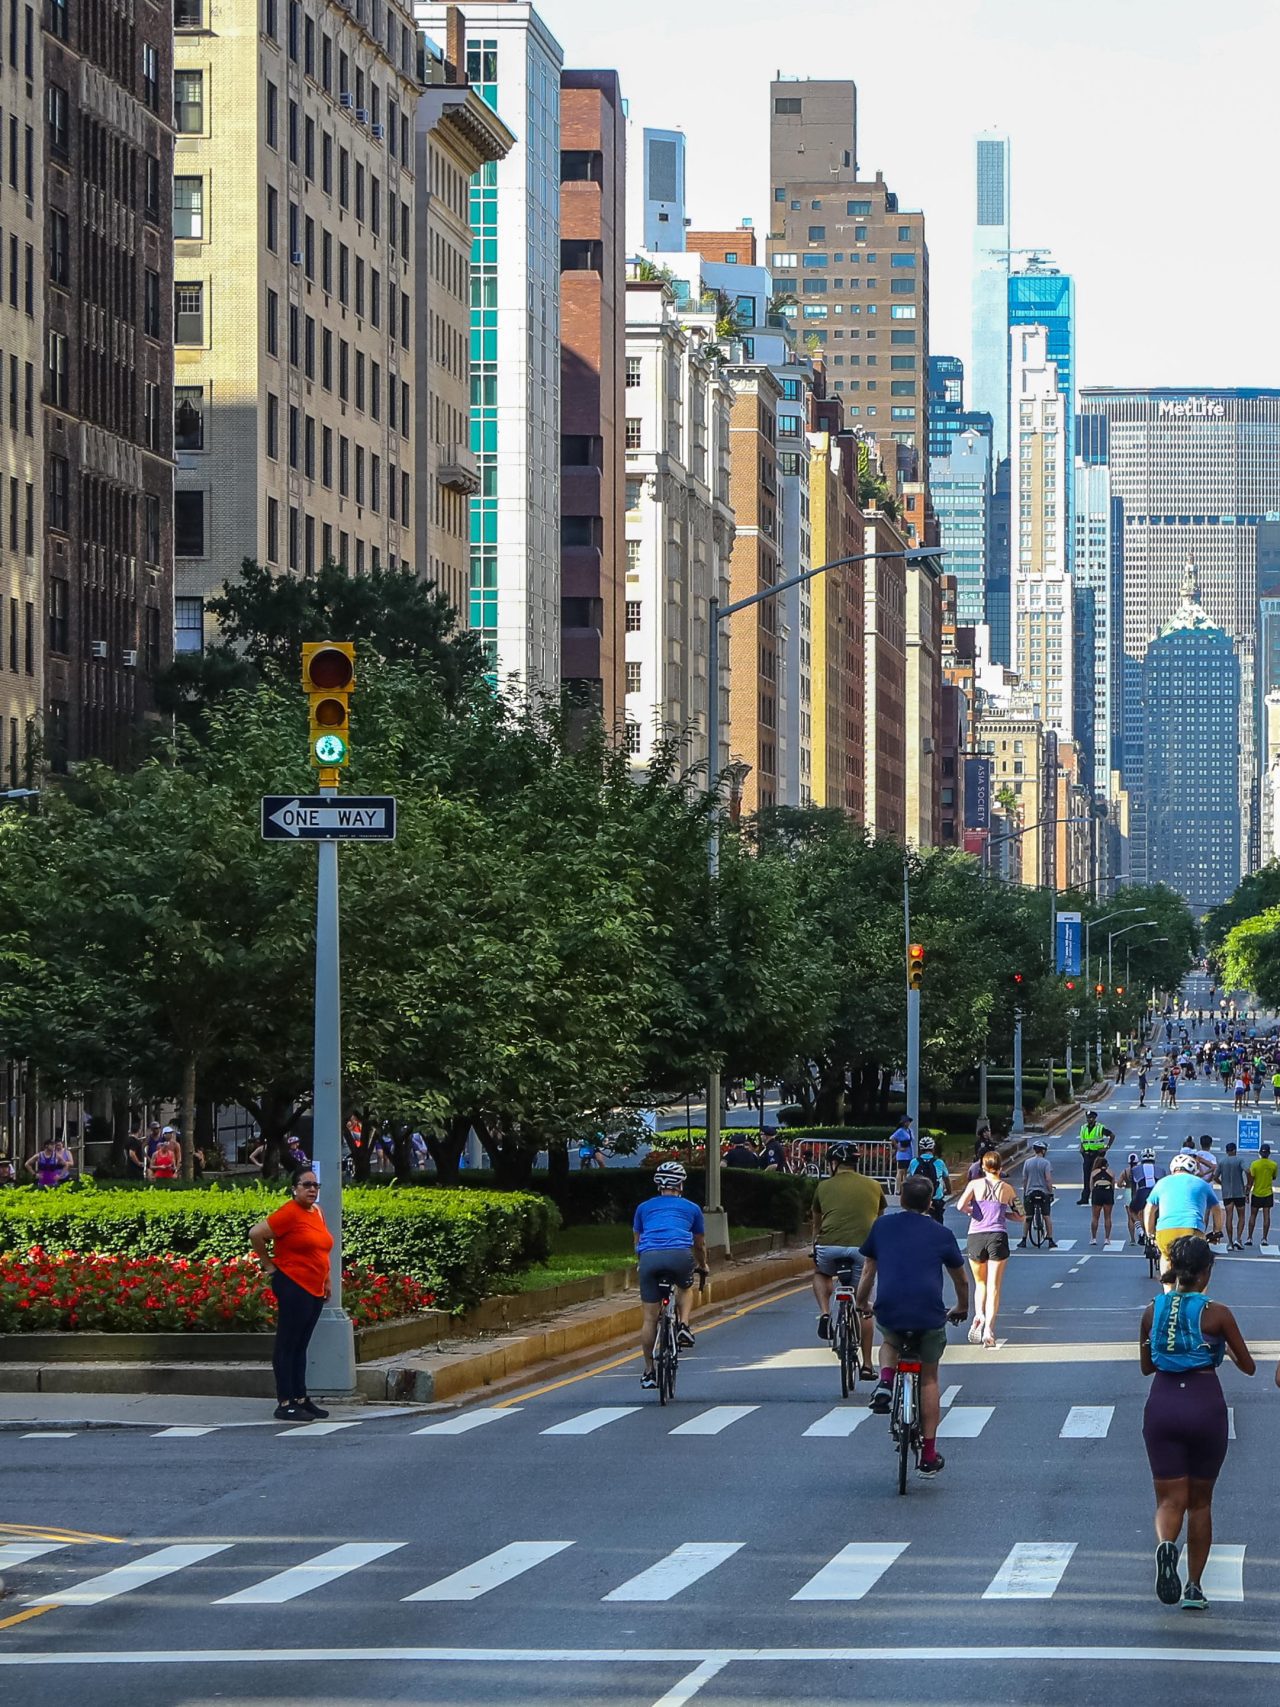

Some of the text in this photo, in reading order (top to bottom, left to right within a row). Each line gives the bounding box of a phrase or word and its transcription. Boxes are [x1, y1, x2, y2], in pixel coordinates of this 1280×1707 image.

[1160, 397, 1224, 416] MetLife
[283, 810, 377, 826] ONE WAY
[1168, 1296, 1181, 1351] NATHAN
